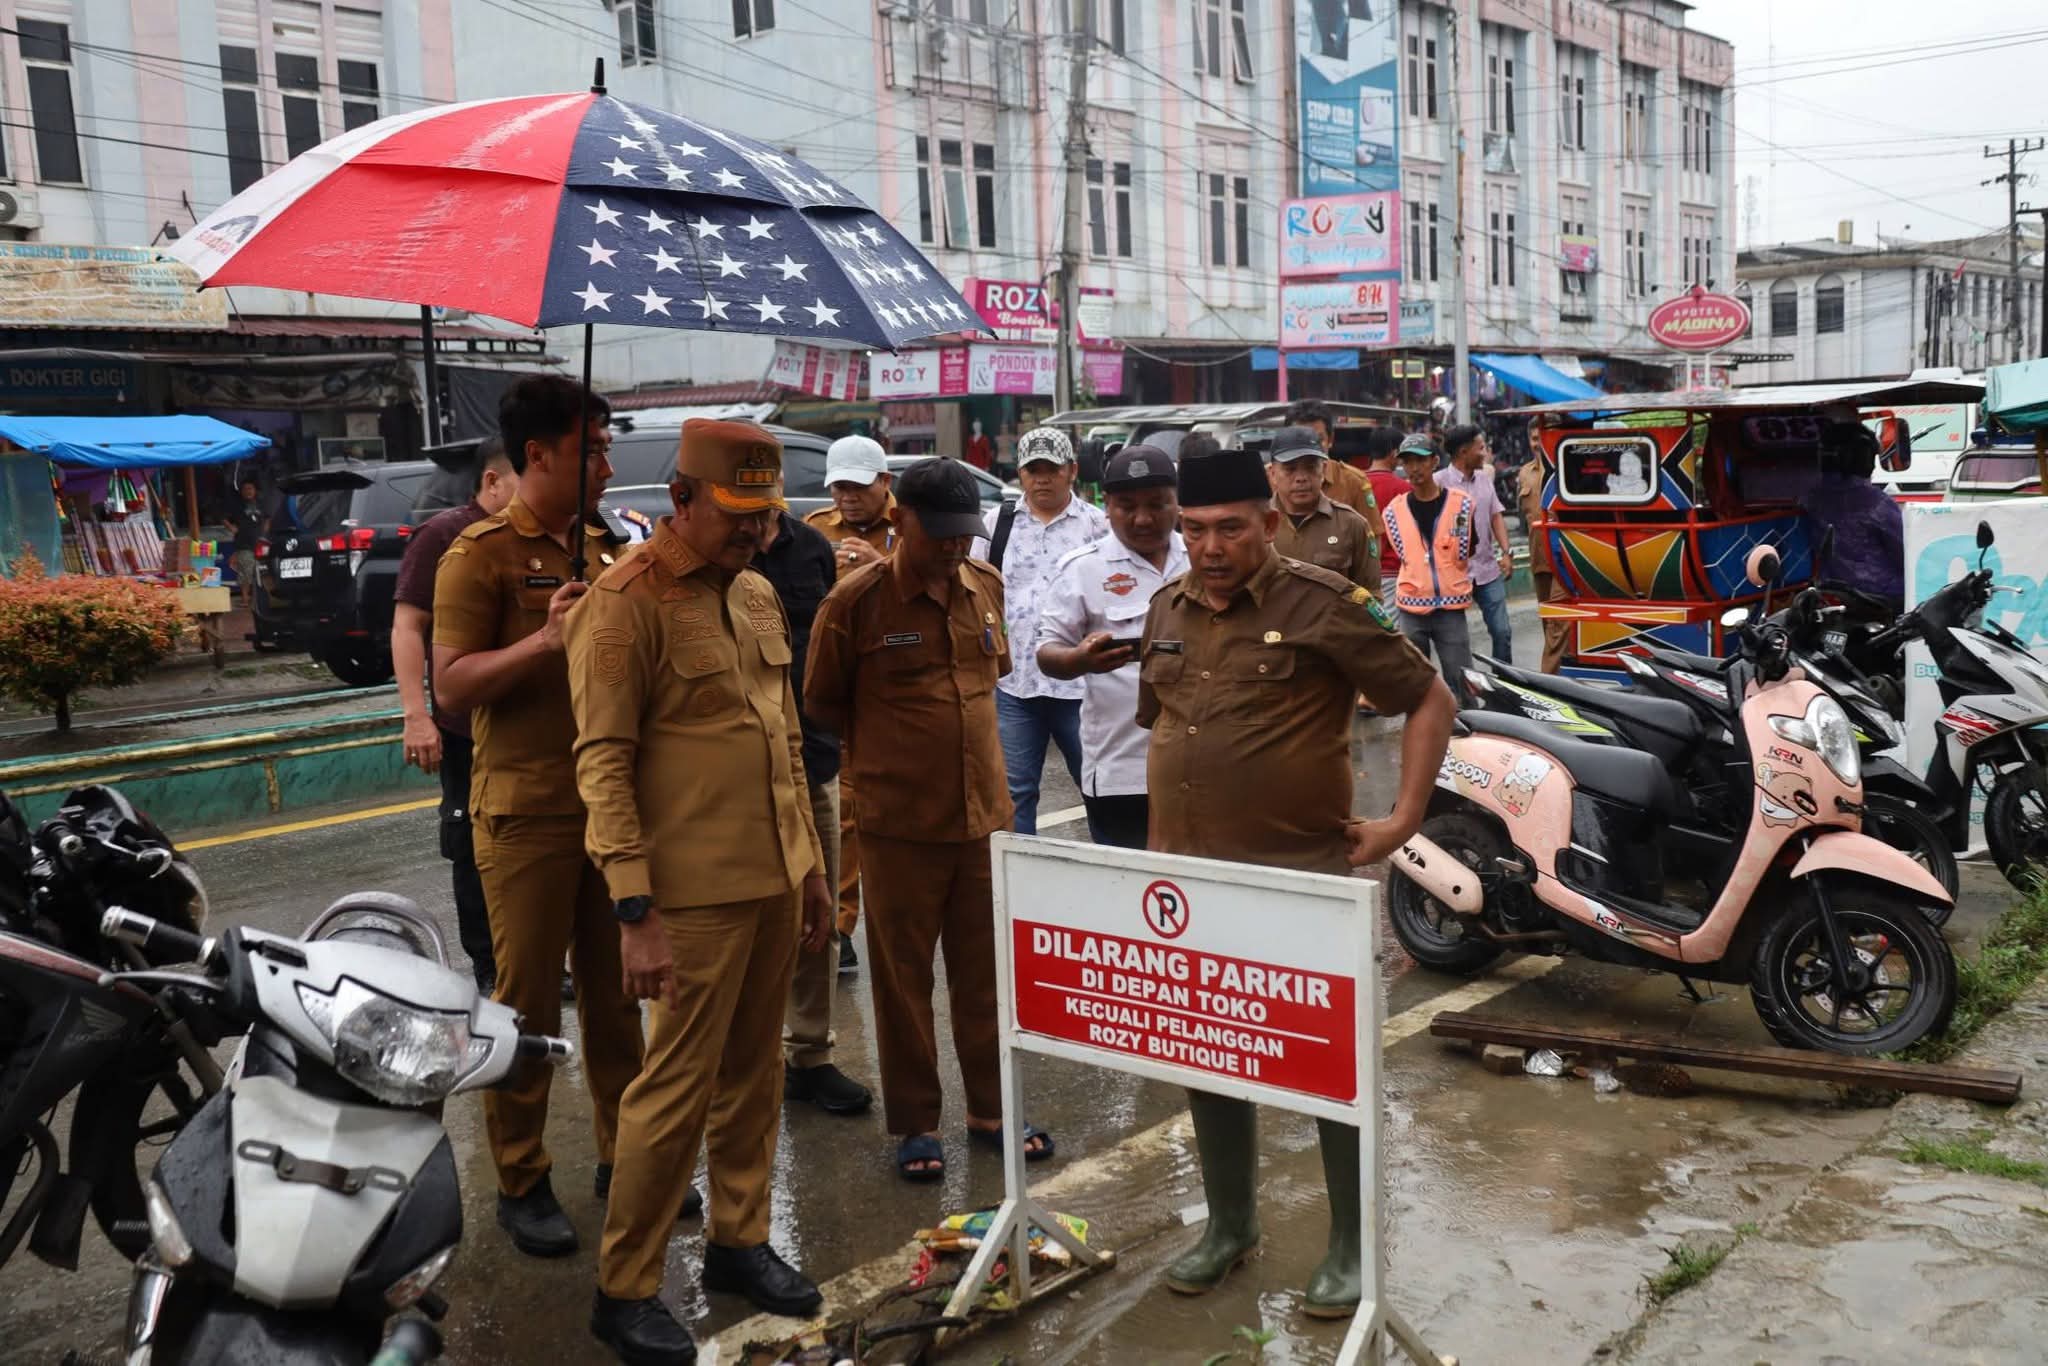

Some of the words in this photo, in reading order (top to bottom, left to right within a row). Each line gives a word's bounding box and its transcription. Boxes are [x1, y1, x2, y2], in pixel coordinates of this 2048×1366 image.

[1673, 307, 1721, 317] APOTEK
[1662, 316, 1736, 334] MADINA
[989, 354, 1037, 371] PONDOK
[10, 368, 83, 386] DOKTER
[89, 368, 126, 386] GIGI
[881, 367, 927, 384] ROZY
[1033, 928, 1189, 980] DILARANG
[1200, 957, 1331, 1009] PARKIR
[1082, 968, 1104, 991] DI
[1112, 972, 1189, 1008] DEPAN
[1197, 990, 1267, 1023] TOKO
[1066, 997, 1150, 1029] KECUALI
[1157, 1014, 1284, 1059] PELANGGAN
[1090, 1024, 1142, 1050] ROZY
[1148, 1037, 1239, 1075] BUTIQUE
[1245, 1058, 1260, 1077] II
